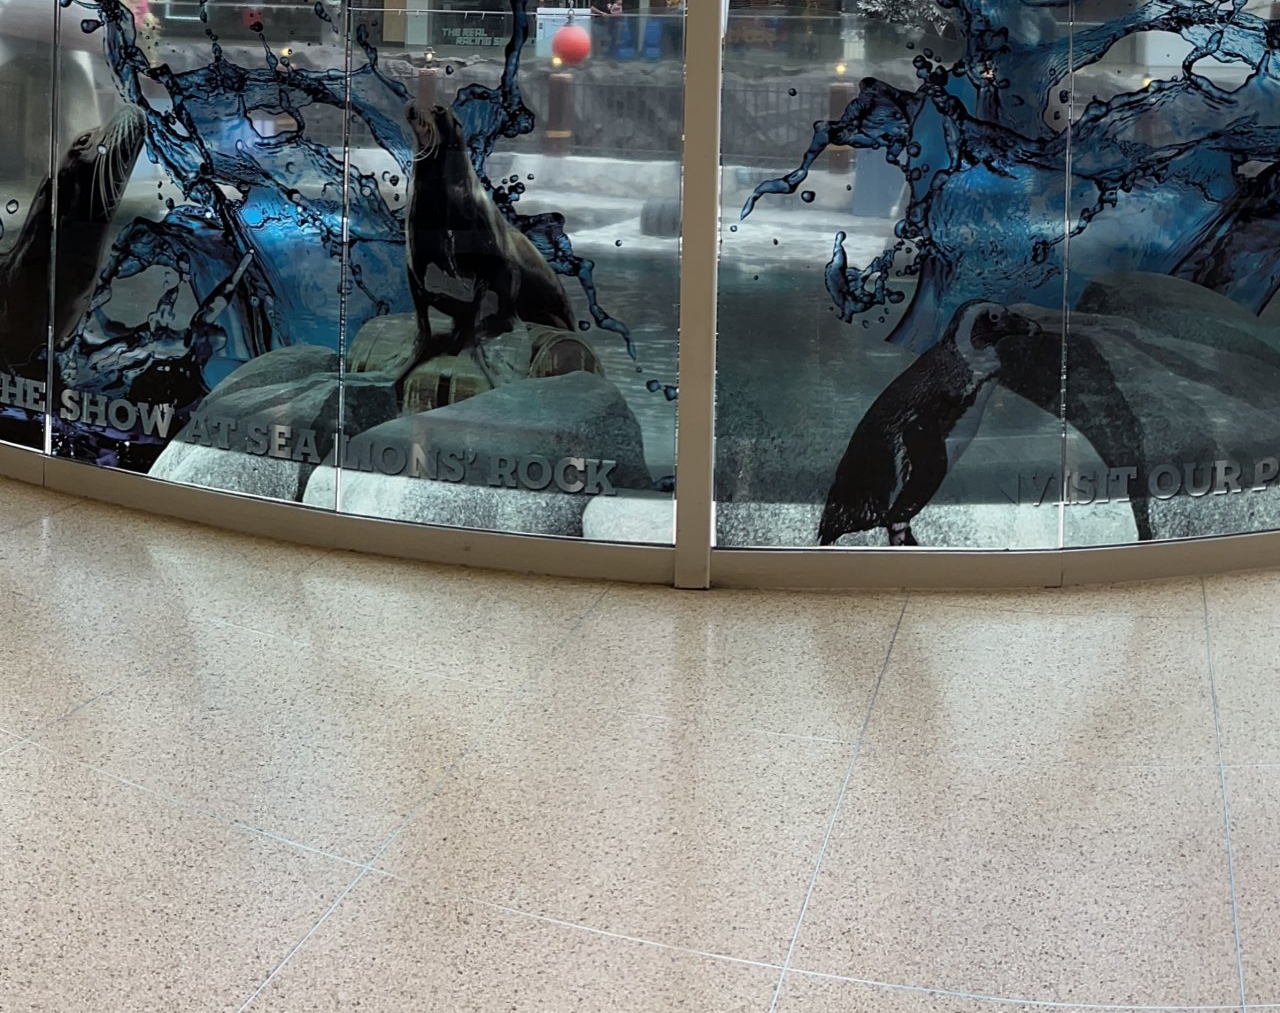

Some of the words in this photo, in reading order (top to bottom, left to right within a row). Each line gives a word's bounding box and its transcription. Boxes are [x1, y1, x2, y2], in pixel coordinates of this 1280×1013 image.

[60, 389, 175, 438] SHOW
[185, 410, 237, 451] AT
[245, 421, 320, 465] SEA
[486, 454, 618, 496] ROCK
[1147, 459, 1244, 499] OUR
